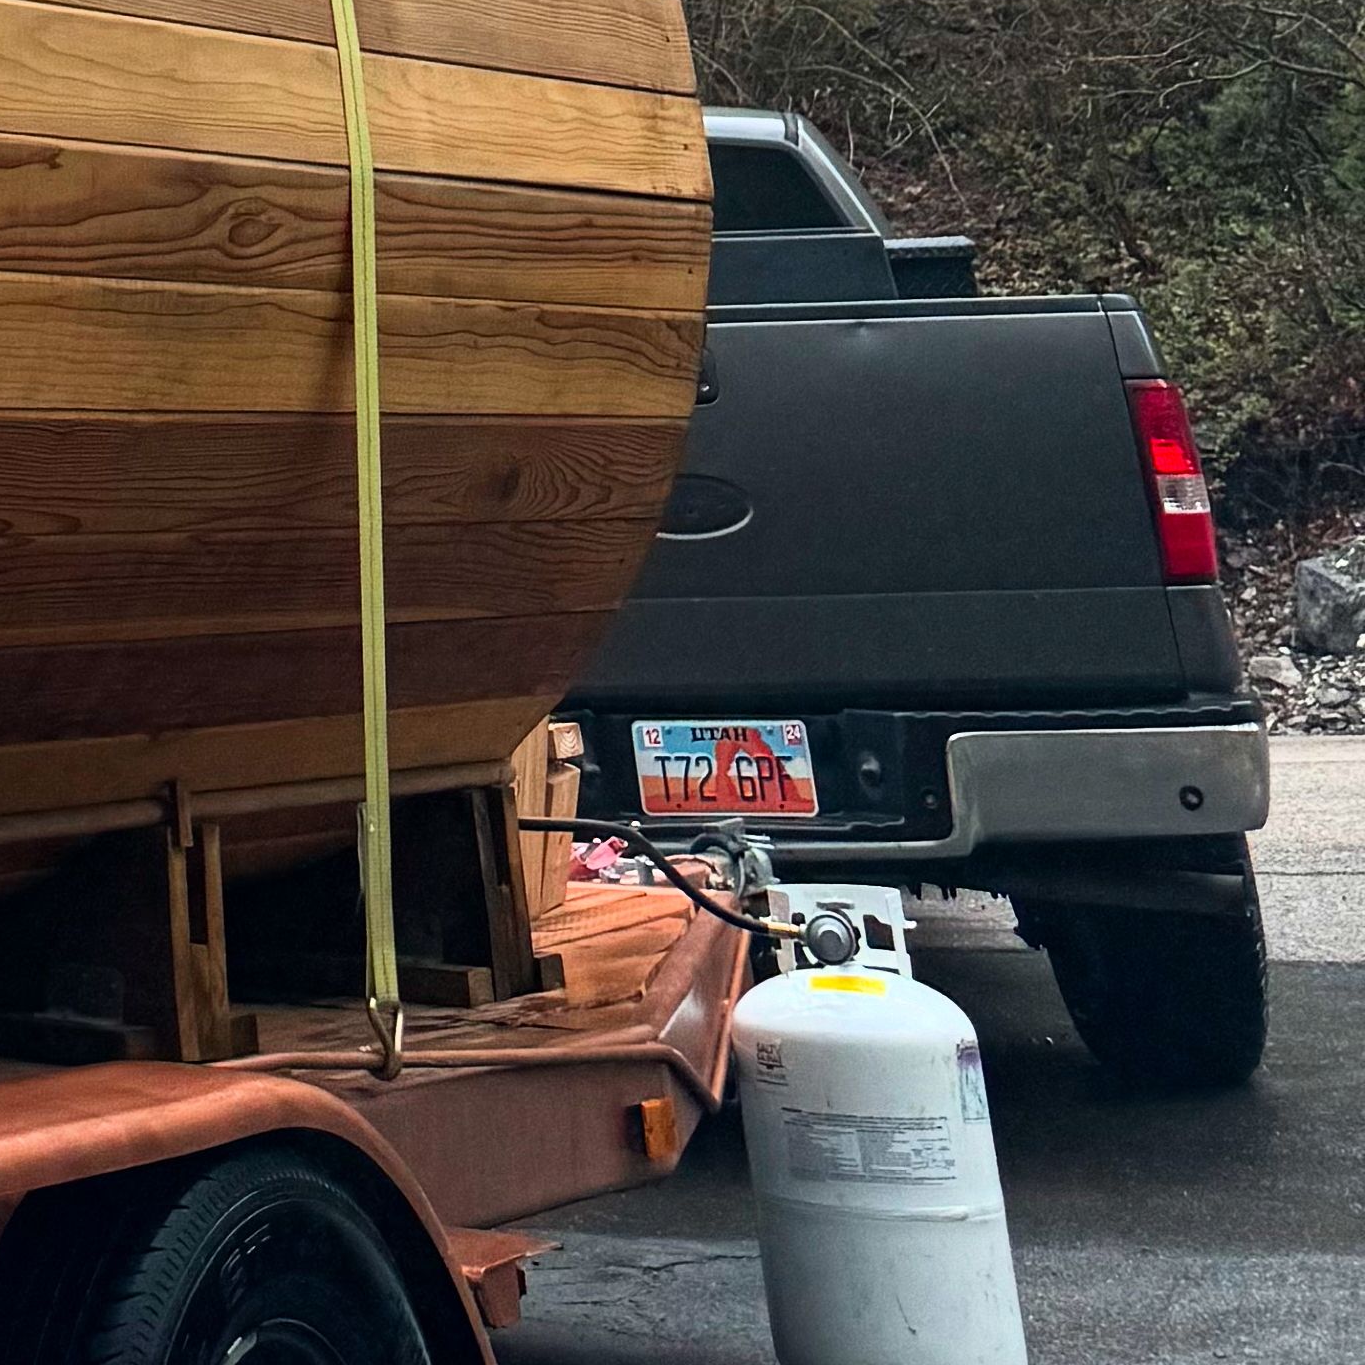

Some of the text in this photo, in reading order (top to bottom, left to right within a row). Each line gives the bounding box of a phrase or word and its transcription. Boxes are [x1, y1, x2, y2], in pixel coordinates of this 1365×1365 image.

[645, 728, 661, 745] 12
[690, 727, 748, 742] UTAH
[654, 755, 717, 803] T72
